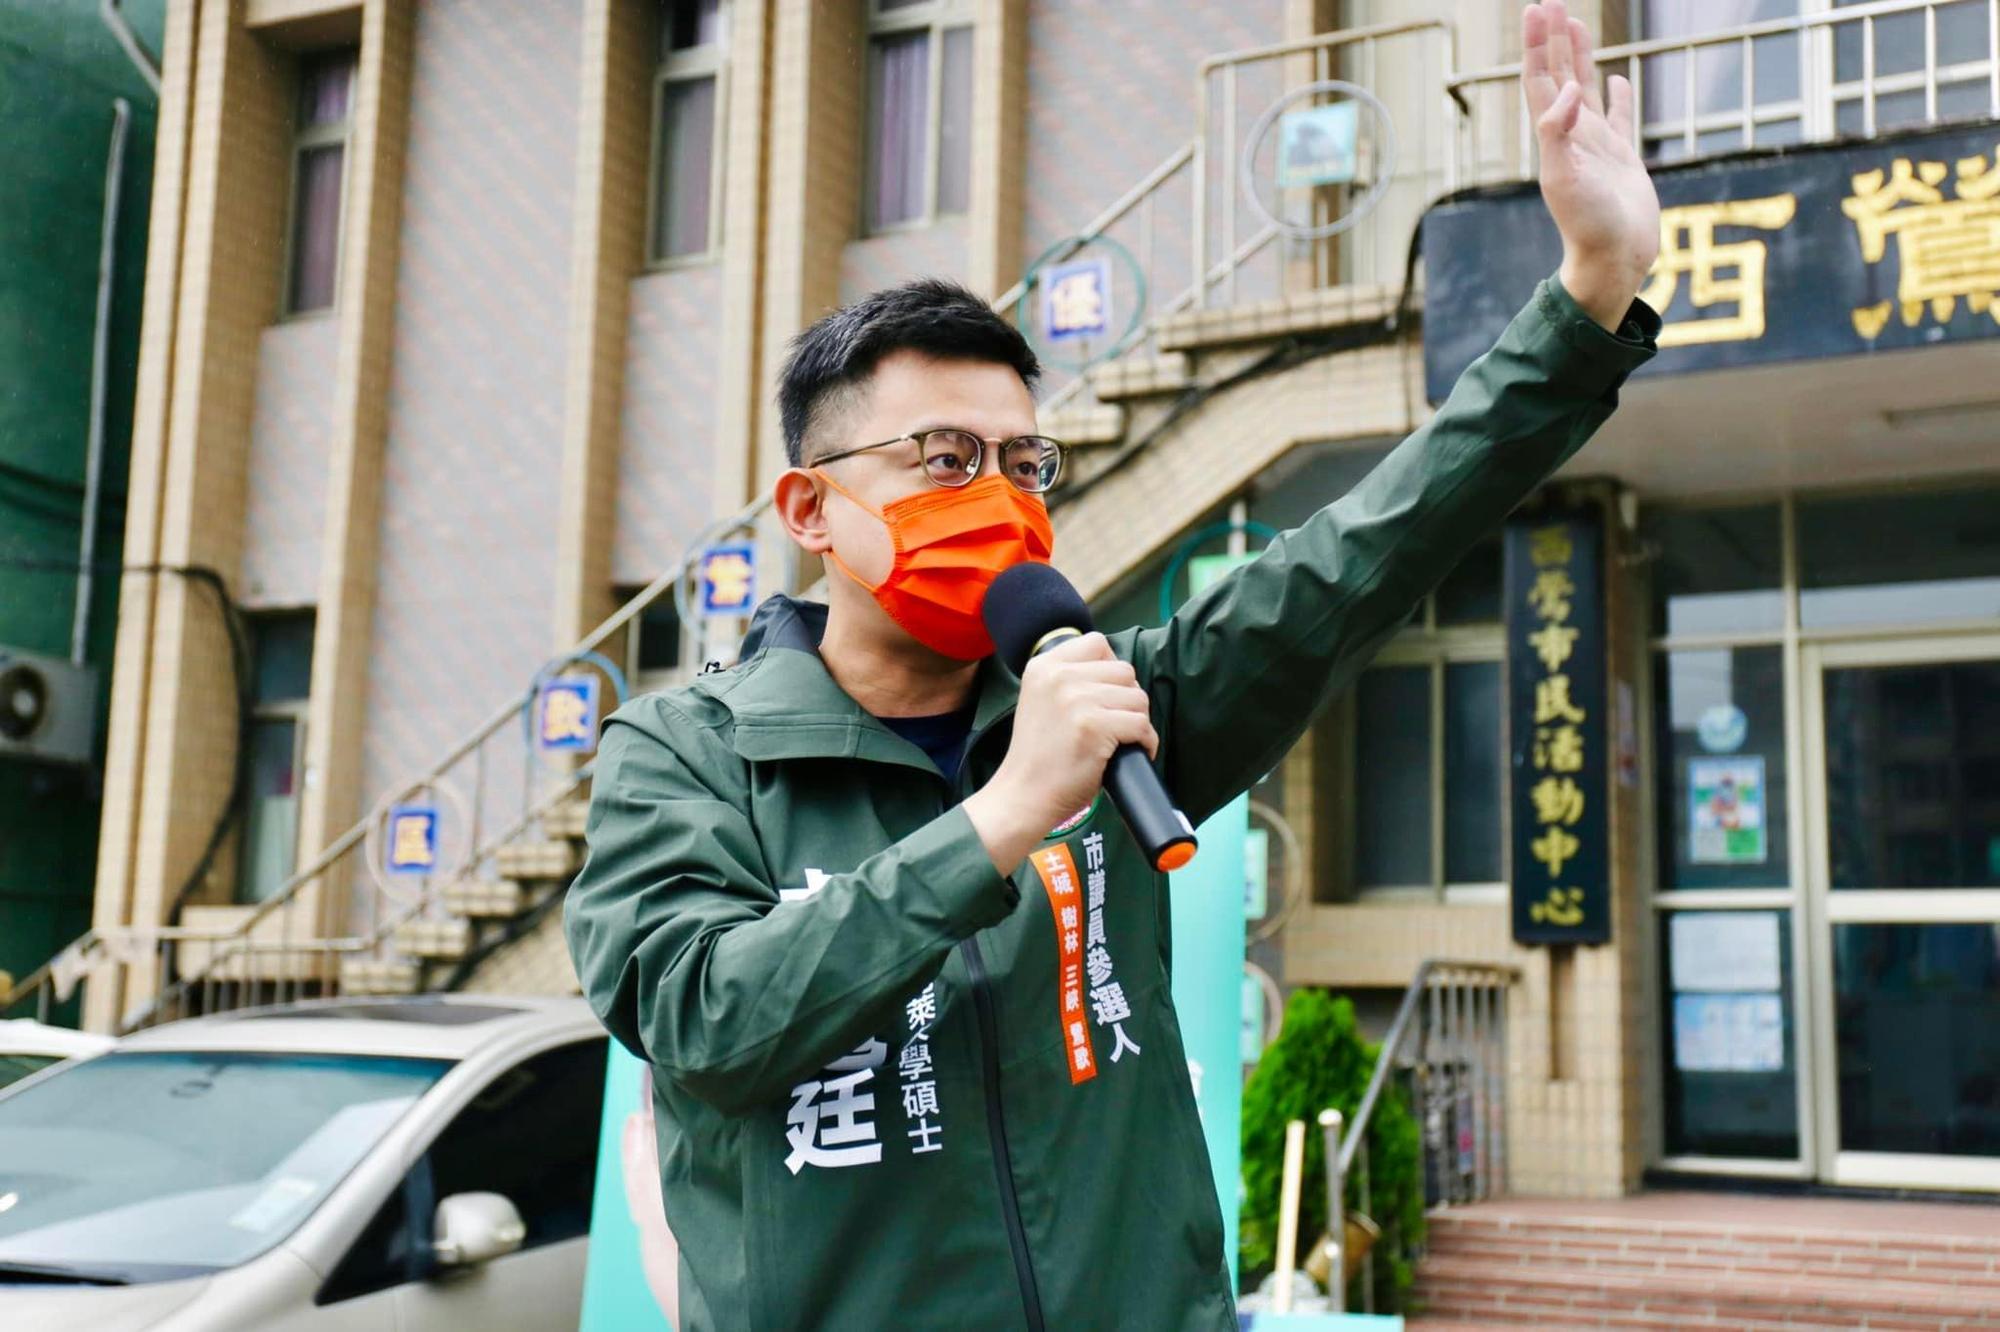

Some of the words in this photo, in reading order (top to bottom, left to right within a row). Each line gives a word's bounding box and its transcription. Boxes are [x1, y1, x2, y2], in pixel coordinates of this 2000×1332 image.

[1044, 852, 1075, 895] 土城
[1061, 904, 1079, 955] 樹林
[1082, 831, 1141, 1063] 市議員參選人
